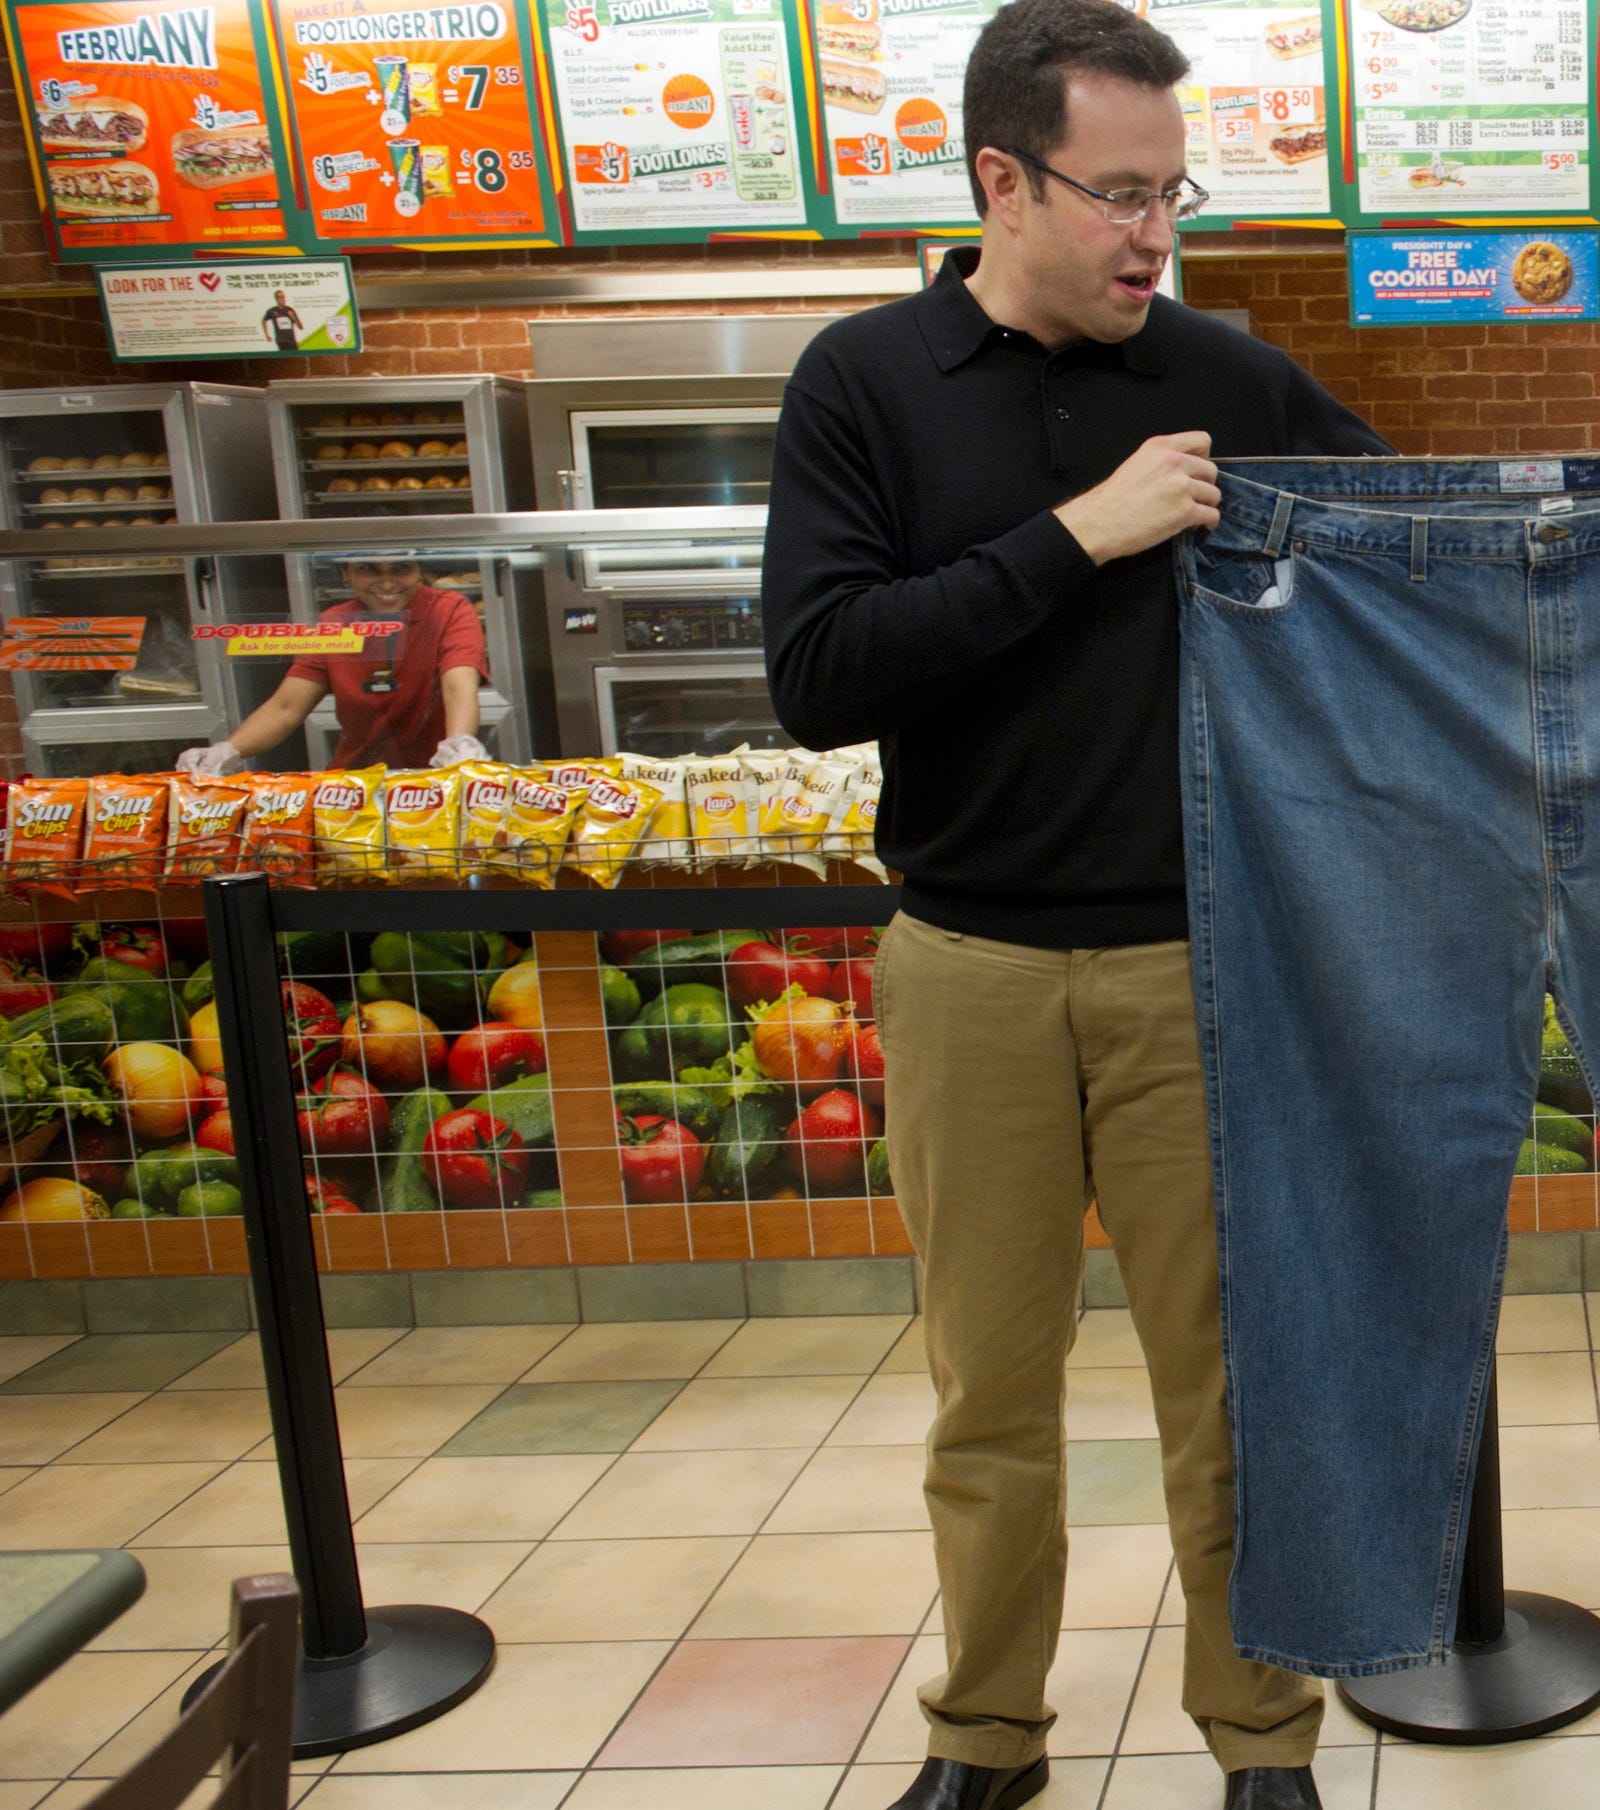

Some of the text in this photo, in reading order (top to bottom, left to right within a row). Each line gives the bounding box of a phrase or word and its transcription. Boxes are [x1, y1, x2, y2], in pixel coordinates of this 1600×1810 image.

[297, 4, 499, 42] FOOTLONGER TRIO
[567, 7, 600, 43] $5
[61, 8, 212, 67] FEBRUANY
[723, 32, 776, 42] Value Meal
[306, 66, 327, 92] $5
[495, 67, 520, 85] 35
[41, 79, 61, 102] $6
[1292, 90, 1311, 106] 50
[1383, 83, 1398, 93] 50
[197, 108, 216, 129] $5
[1364, 107, 1406, 121] Extras
[315, 155, 336, 180] $6
[510, 152, 534, 168] 35
[601, 144, 728, 178] $5 FOOTLONGS
[1367, 154, 1400, 167] Kids
[1561, 154, 1575, 164] 00
[251, 226, 282, 234] OTHERS
[1447, 242, 1463, 250] DAY
[1408, 250, 1458, 269] FREE
[106, 276, 194, 294] LOOK FOR THE
[1368, 268, 1498, 288] COOKIE DAY!
[191, 621, 405, 641] DOUBLE UP
[238, 640, 356, 651] Ask for double meat
[15, 799, 73, 827] Sun
[95, 793, 154, 822] Sun
[180, 799, 238, 825] Sun
[253, 789, 307, 819] Sun
[22, 820, 67, 839] Chips
[103, 811, 144, 833] Chips
